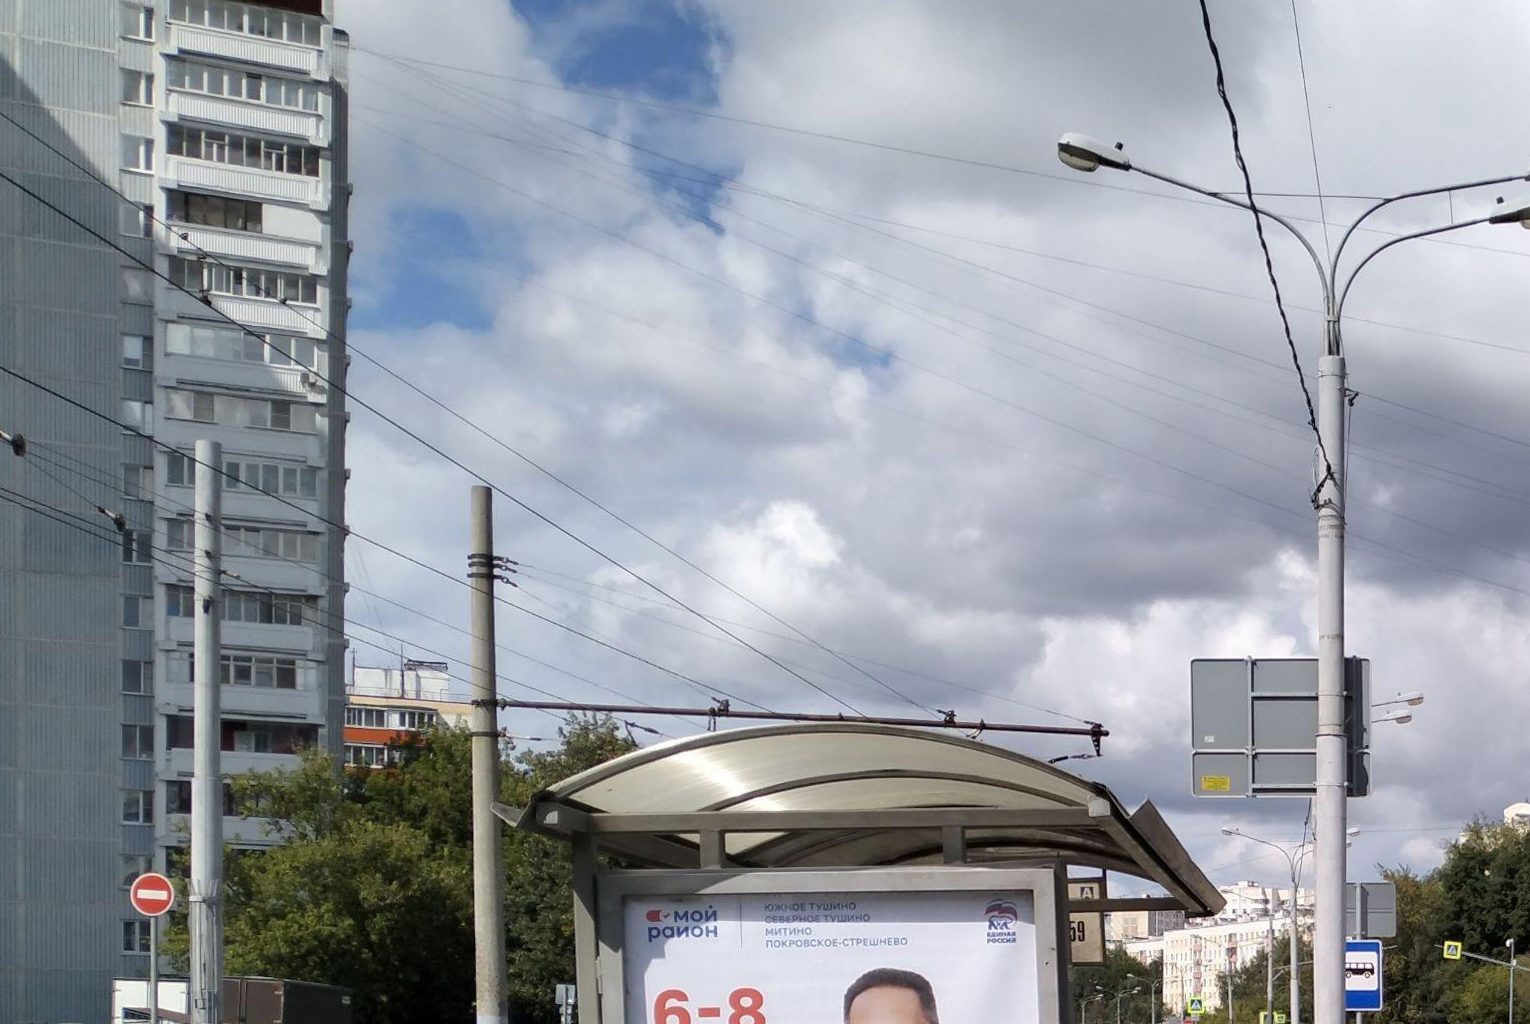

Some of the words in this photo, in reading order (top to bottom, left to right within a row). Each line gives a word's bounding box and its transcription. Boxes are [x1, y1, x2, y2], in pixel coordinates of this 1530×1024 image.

[764, 903, 806, 912] ЮЖНОЕ
[810, 902, 856, 911] ТУШИНО
[673, 905, 718, 923] мой
[765, 915, 820, 924] СЕВЕРНОЕ
[824, 914, 871, 923] ТУШИНО
[765, 927, 812, 936] МИТИНО
[766, 938, 908, 948] ПОКРОВСКОЕ-СТРЕШНЕВО
